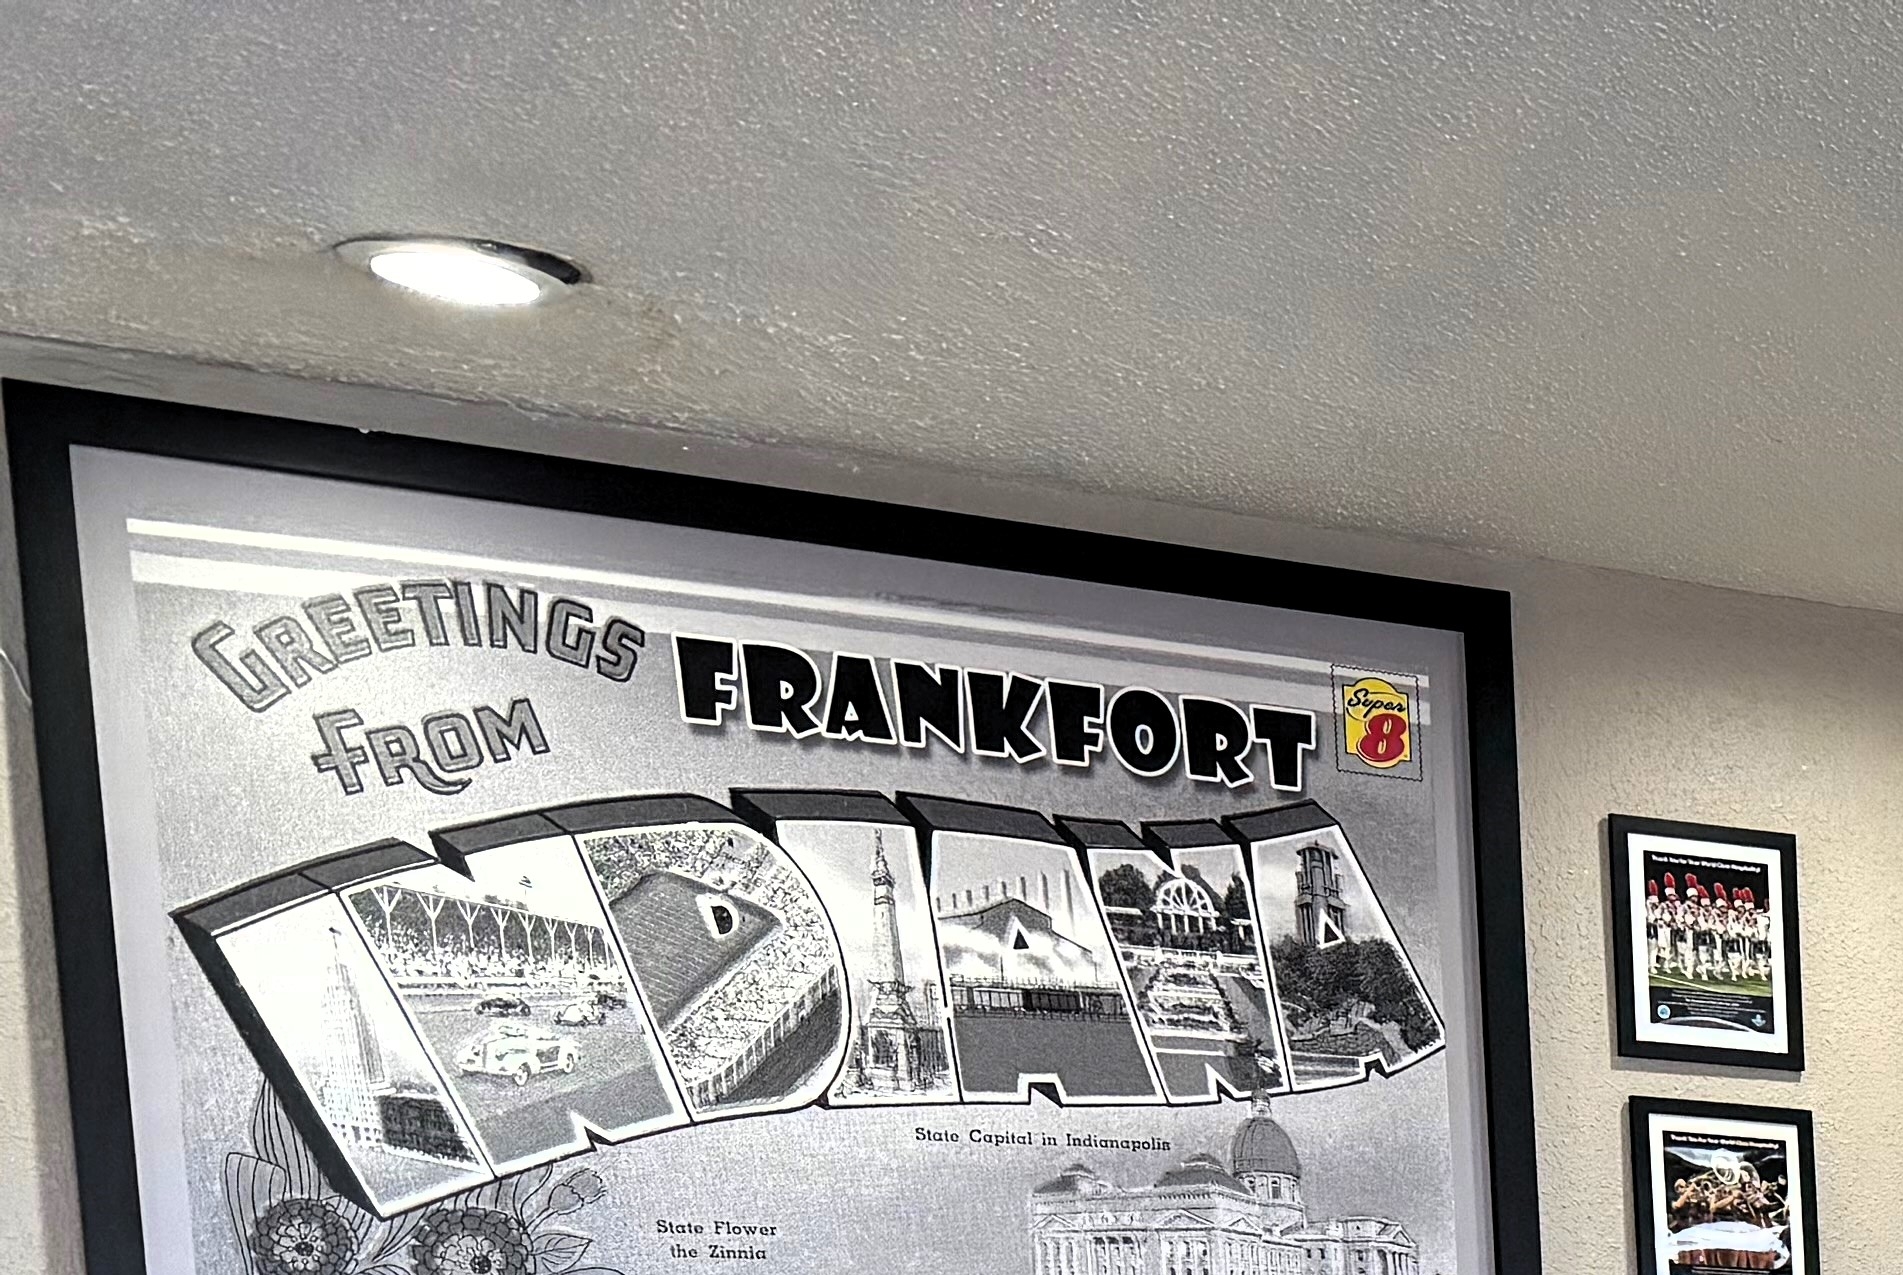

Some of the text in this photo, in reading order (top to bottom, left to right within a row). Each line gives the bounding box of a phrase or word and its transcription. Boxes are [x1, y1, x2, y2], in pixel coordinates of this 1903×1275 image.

[191, 578, 646, 713] GREETINGS
[673, 632, 1316, 791] FRANKFORT
[1347, 688, 1406, 718] Super
[311, 698, 551, 795] FROM
[1357, 713, 1407, 762] 8
[170, 788, 1447, 1221] INDIANA
[915, 1126, 1172, 1152] State Capital in Indianapolis
[656, 1219, 777, 1236] State Flower
[670, 1243, 767, 1260] the Zinnia
